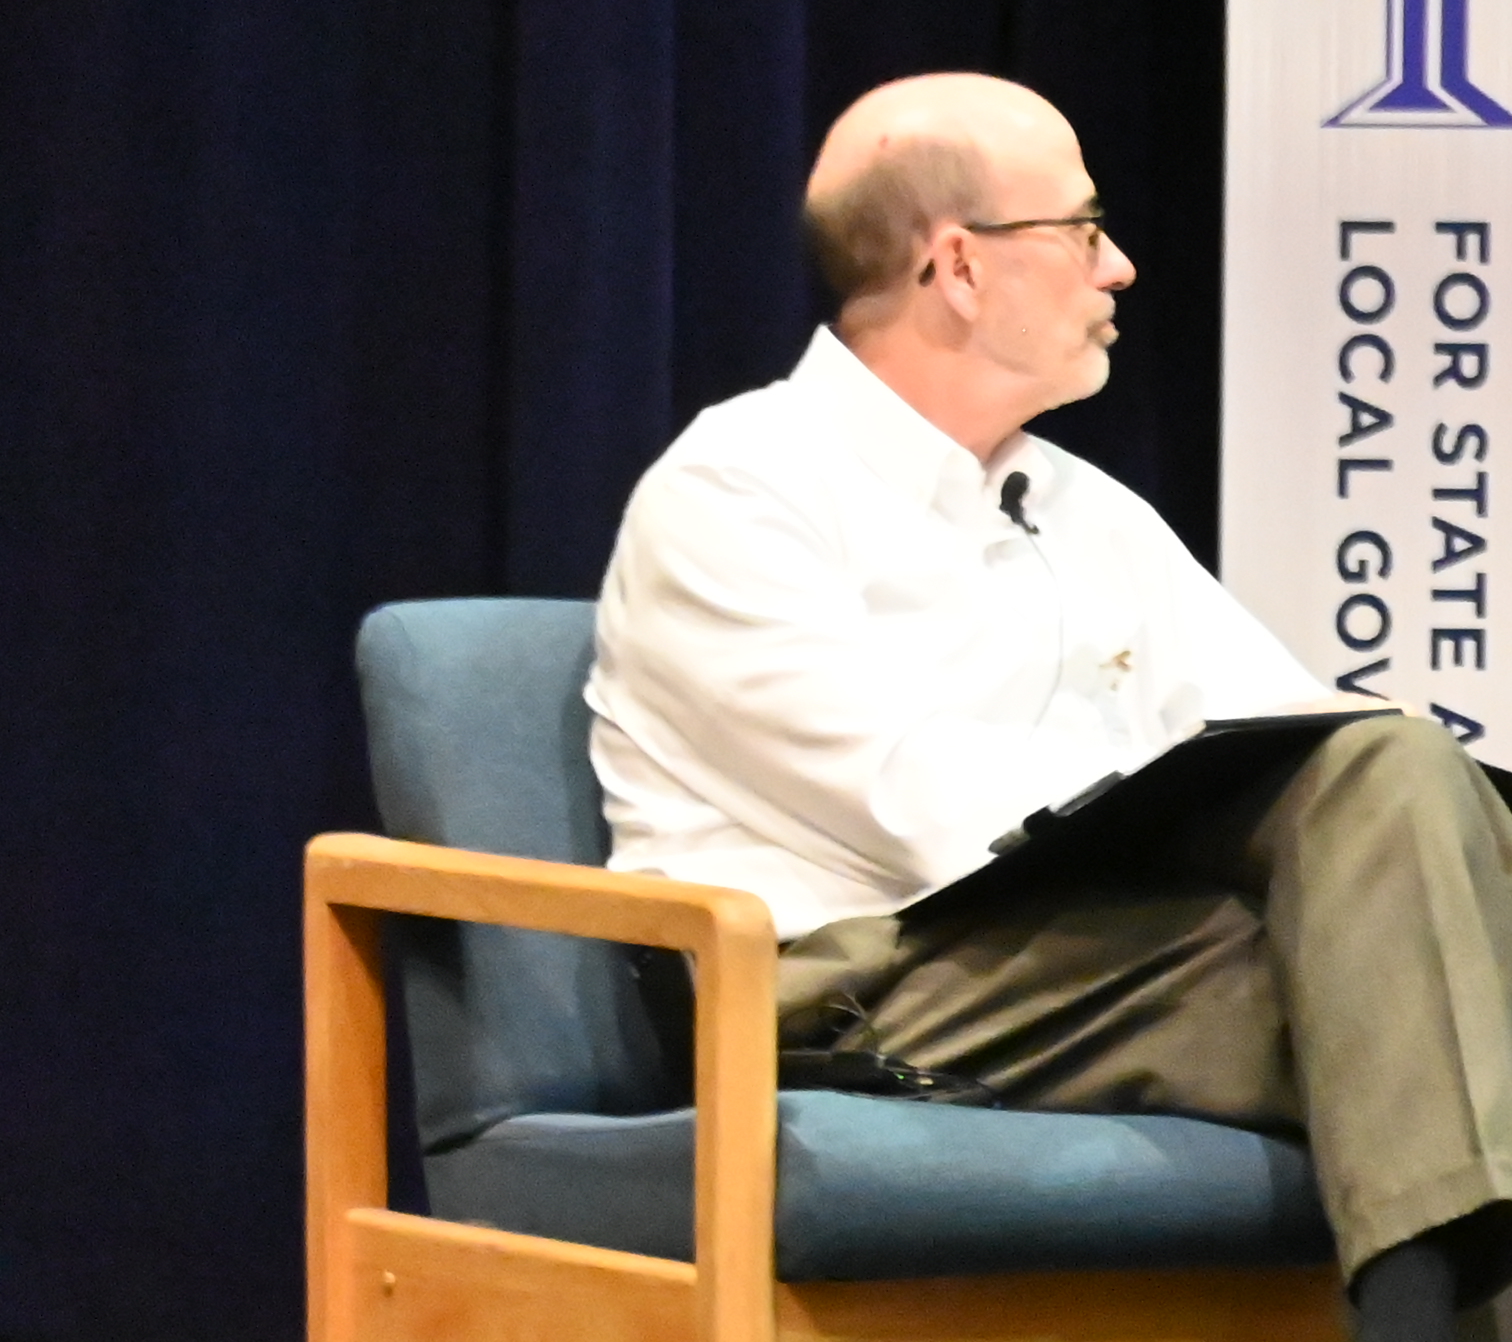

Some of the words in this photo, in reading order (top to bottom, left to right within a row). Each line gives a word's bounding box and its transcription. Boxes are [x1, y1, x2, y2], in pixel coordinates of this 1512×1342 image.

[1336, 219, 1396, 500] LOCAL
[1432, 221, 1491, 390] FOR
[1429, 421, 1489, 671] STATE
